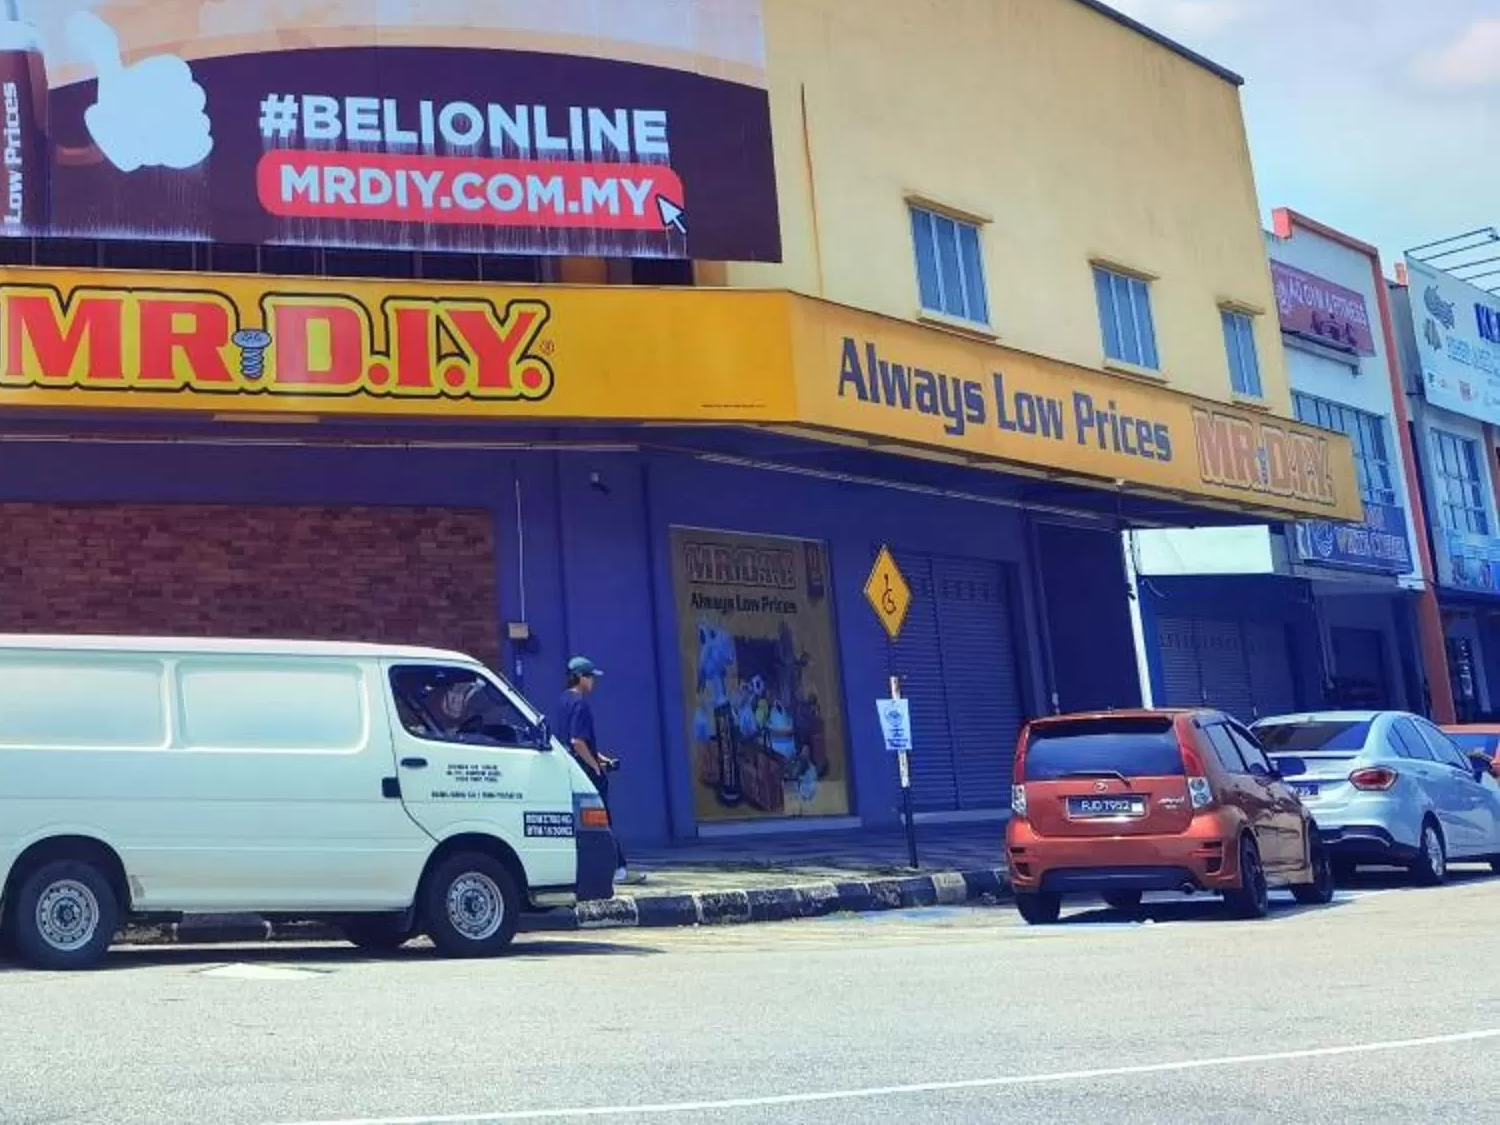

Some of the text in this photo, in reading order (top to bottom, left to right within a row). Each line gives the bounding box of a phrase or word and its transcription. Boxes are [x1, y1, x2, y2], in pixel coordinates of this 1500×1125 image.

[3, 82, 23, 224] Low Prices
[259, 93, 668, 155] #BELIONLINE
[280, 165, 654, 217] MRDIY.COM.MY
[838, 337, 1173, 462] Always Low Prices
